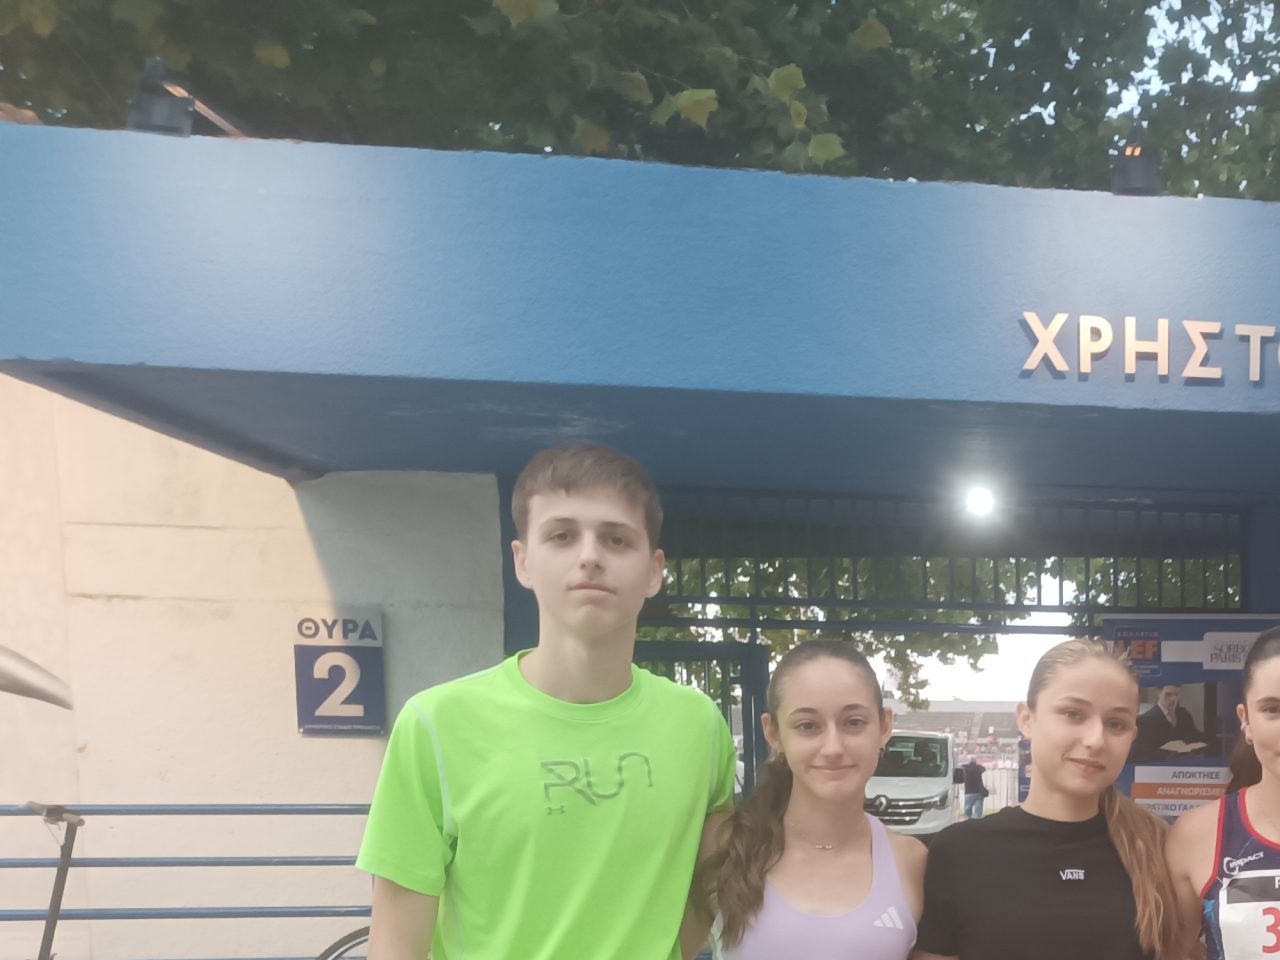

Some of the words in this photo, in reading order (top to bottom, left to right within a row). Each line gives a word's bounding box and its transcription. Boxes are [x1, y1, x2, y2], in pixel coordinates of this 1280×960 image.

[297, 617, 378, 641] ΘΥΡΑ
[313, 651, 365, 717] 2
[1171, 770, 1221, 780] ΑΠΟΚΤΗΣΕ
[1059, 868, 1085, 880] VANS
